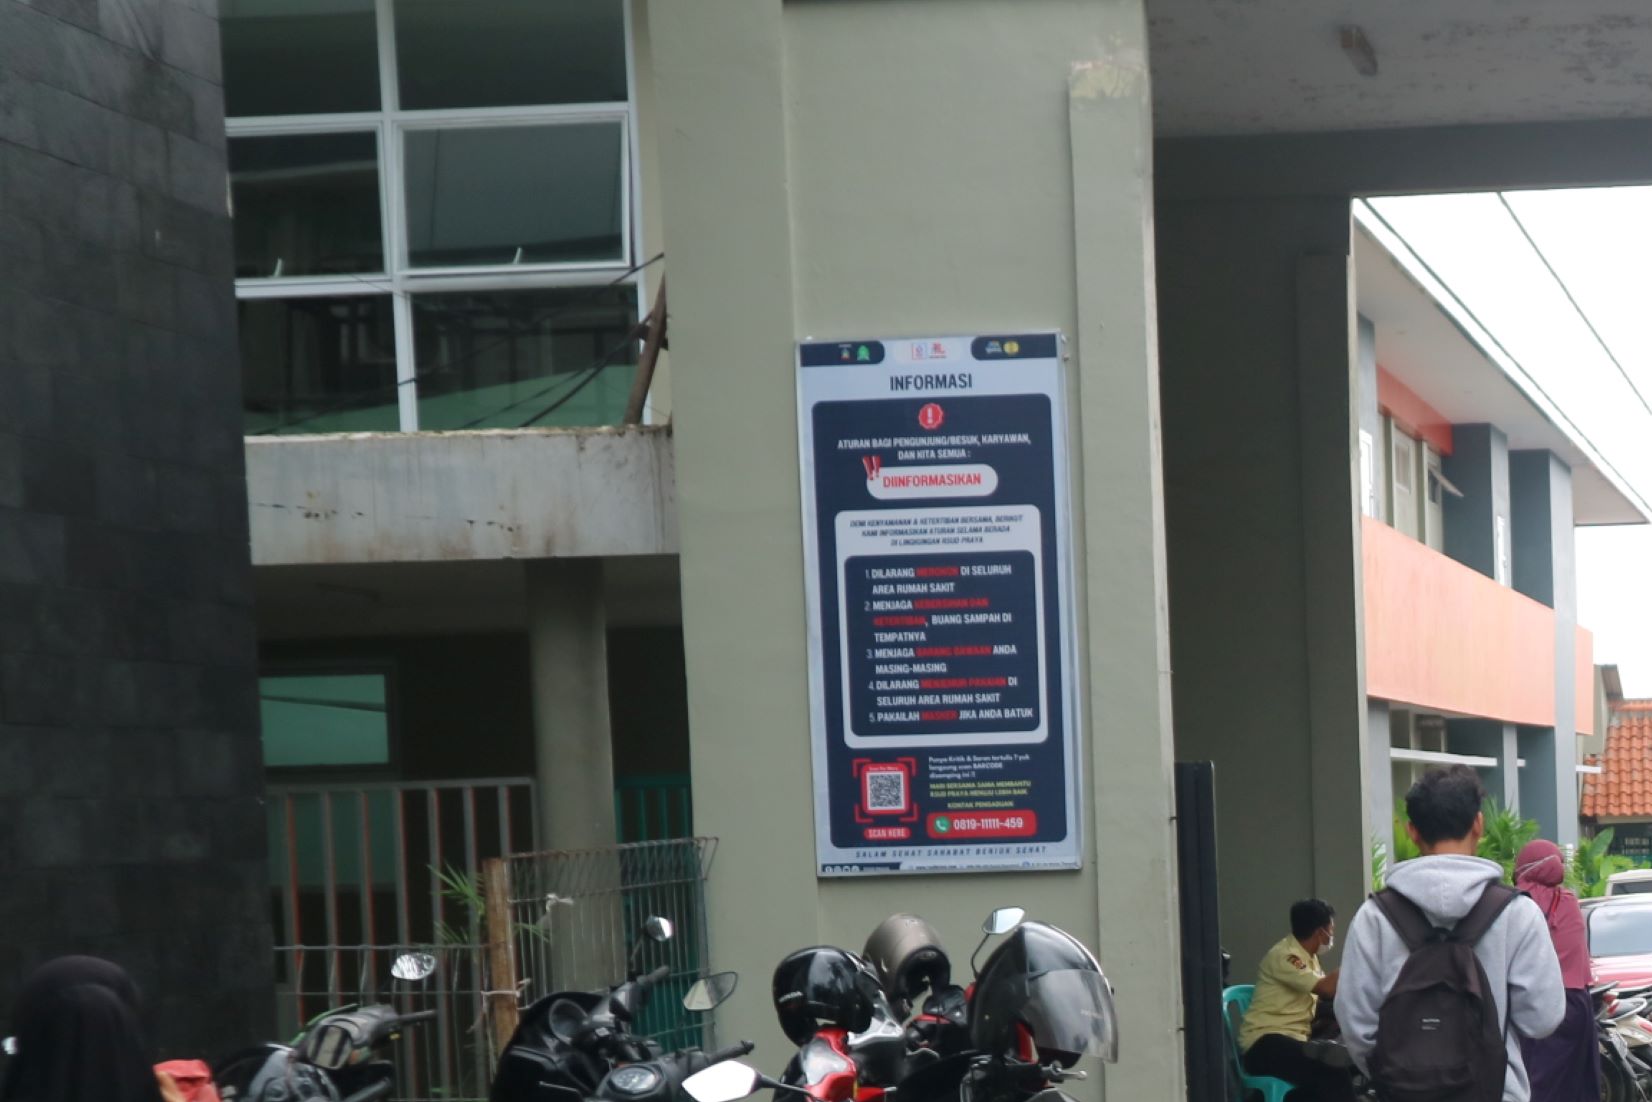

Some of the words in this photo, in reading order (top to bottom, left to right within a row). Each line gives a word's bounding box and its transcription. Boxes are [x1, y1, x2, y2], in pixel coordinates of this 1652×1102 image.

[890, 373, 972, 391] INFORMASI
[838, 439, 870, 449] ATURAN
[872, 438, 892, 448] BAGI
[898, 451, 916, 460] DAN
[918, 450, 935, 459] KITA
[937, 449, 966, 459] SEMUA
[883, 474, 981, 488] DIINFORMASIKAN
[872, 568, 914, 578] DILARANG
[961, 566, 970, 576] DI
[972, 565, 1011, 575] SELURUH
[872, 584, 895, 595] AREA
[897, 584, 928, 594] RUMAH
[930, 582, 955, 593] SAKIT
[873, 600, 912, 610] MENJAGA
[932, 614, 962, 625] BUANG
[964, 613, 1000, 624] SAMPAH
[1002, 612, 1011, 622] DI
[874, 632, 926, 642] TEMPATNYA
[875, 647, 914, 658] MENJAGA
[993, 645, 1016, 655] ANDA
[876, 663, 946, 674] MASING-MASING
[876, 679, 919, 690] DILARANG
[1008, 676, 1017, 686] DI
[877, 695, 916, 706] SELURUH
[918, 695, 940, 705] AREA
[942, 694, 973, 704] RUMAH
[975, 693, 1000, 703] SAKIT
[877, 711, 919, 722] PAKAILAH
[959, 710, 977, 720] JIKA
[978, 709, 1003, 719] ANDA
[1004, 708, 1033, 718] BATUK
